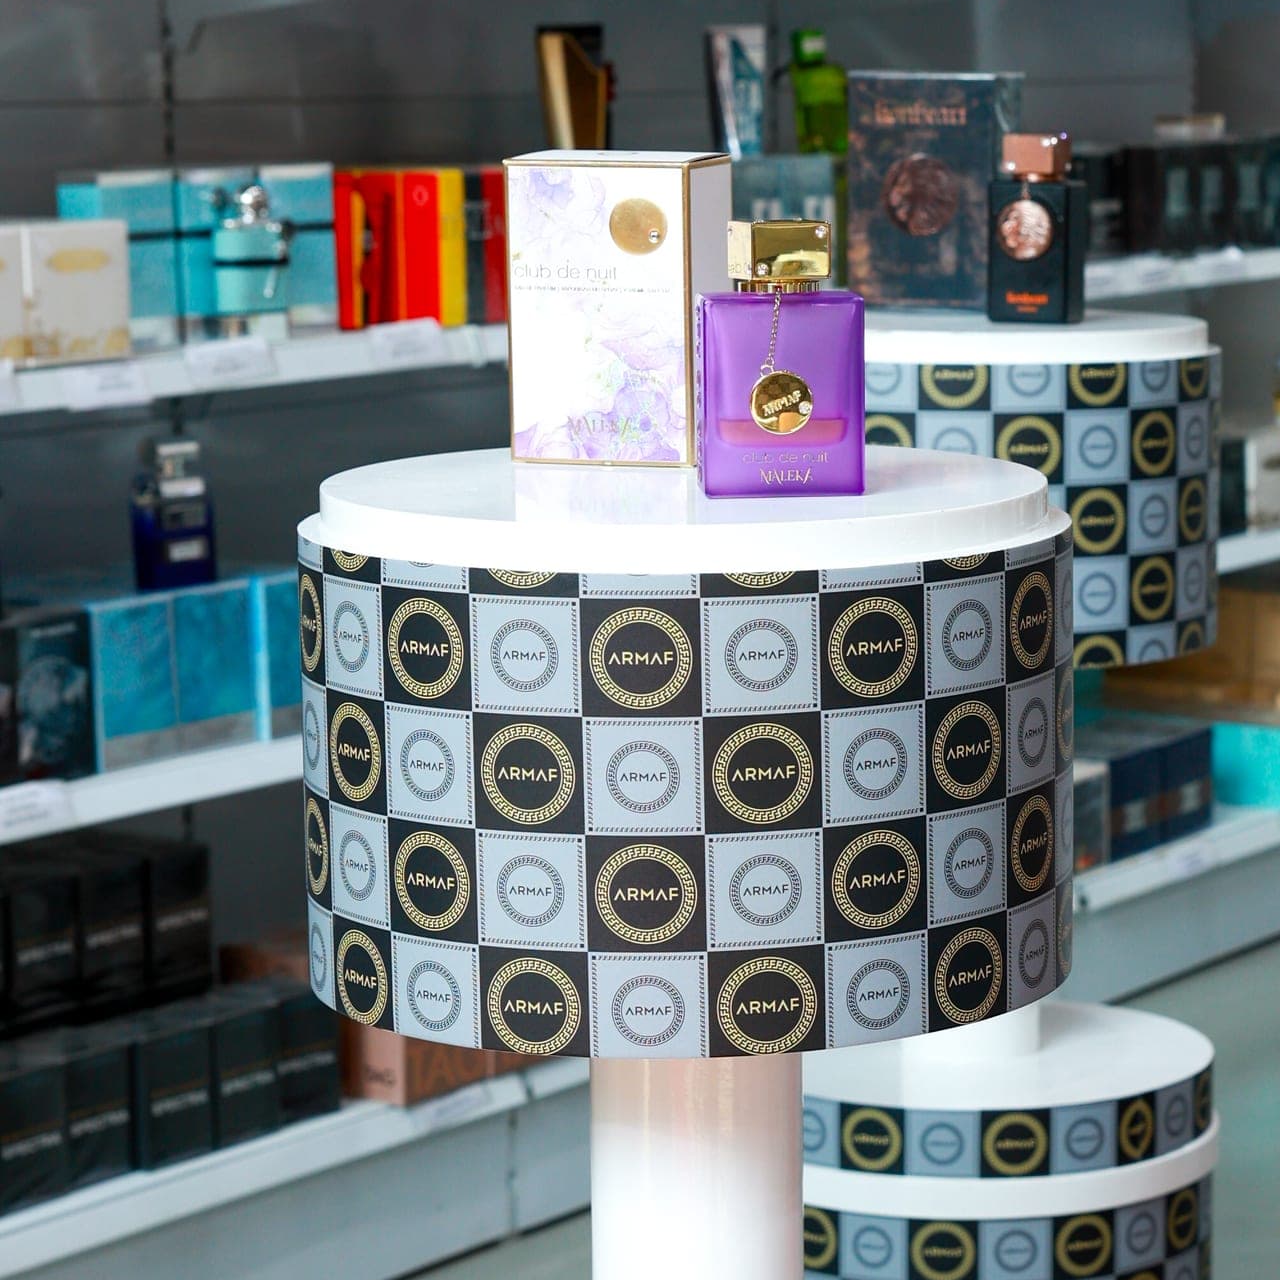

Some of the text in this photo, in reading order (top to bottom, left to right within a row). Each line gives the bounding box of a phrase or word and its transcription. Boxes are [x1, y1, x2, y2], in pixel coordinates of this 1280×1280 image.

[513, 263, 617, 281] club de nuit
[742, 451, 829, 464] club de nuit
[759, 467, 814, 485] MALEKA
[1020, 610, 1047, 631] ARMAF
[339, 631, 361, 643] ARMAF
[953, 628, 984, 642] ARMAF
[401, 641, 448, 656] ARMAF
[847, 638, 902, 656] ARMAF
[503, 651, 545, 661] ARMAF
[609, 652, 673, 665] ARMAF
[739, 650, 784, 661] ARMAF
[1024, 724, 1043, 739] ARMAF
[338, 747, 370, 760] ARMAF
[947, 740, 990, 760] ARMAF
[410, 760, 444, 771] ARMAF
[856, 757, 896, 770] ARMAF
[498, 767, 557, 781] ARMAF
[620, 772, 666, 781] ARMAF
[732, 765, 795, 781] ARMAF
[1021, 832, 1047, 854] ARMAF
[345, 859, 368, 872] ARMAF
[954, 856, 986, 871] ARMAF
[407, 873, 454, 890] ARMAF
[850, 870, 905, 889] ARMAF
[509, 886, 551, 896] ARMAF
[614, 888, 678, 900] ARMAF
[743, 884, 788, 896] ARMAF
[1025, 949, 1045, 964] ARMAF
[345, 969, 376, 988] ARMAF
[949, 965, 991, 987] ARMAF
[417, 990, 451, 1002] ARMAF
[859, 987, 899, 1001] ARMAF
[504, 1000, 563, 1015] ARMAF
[626, 1006, 671, 1015] ARMAF
[736, 998, 799, 1014] ARMAF
